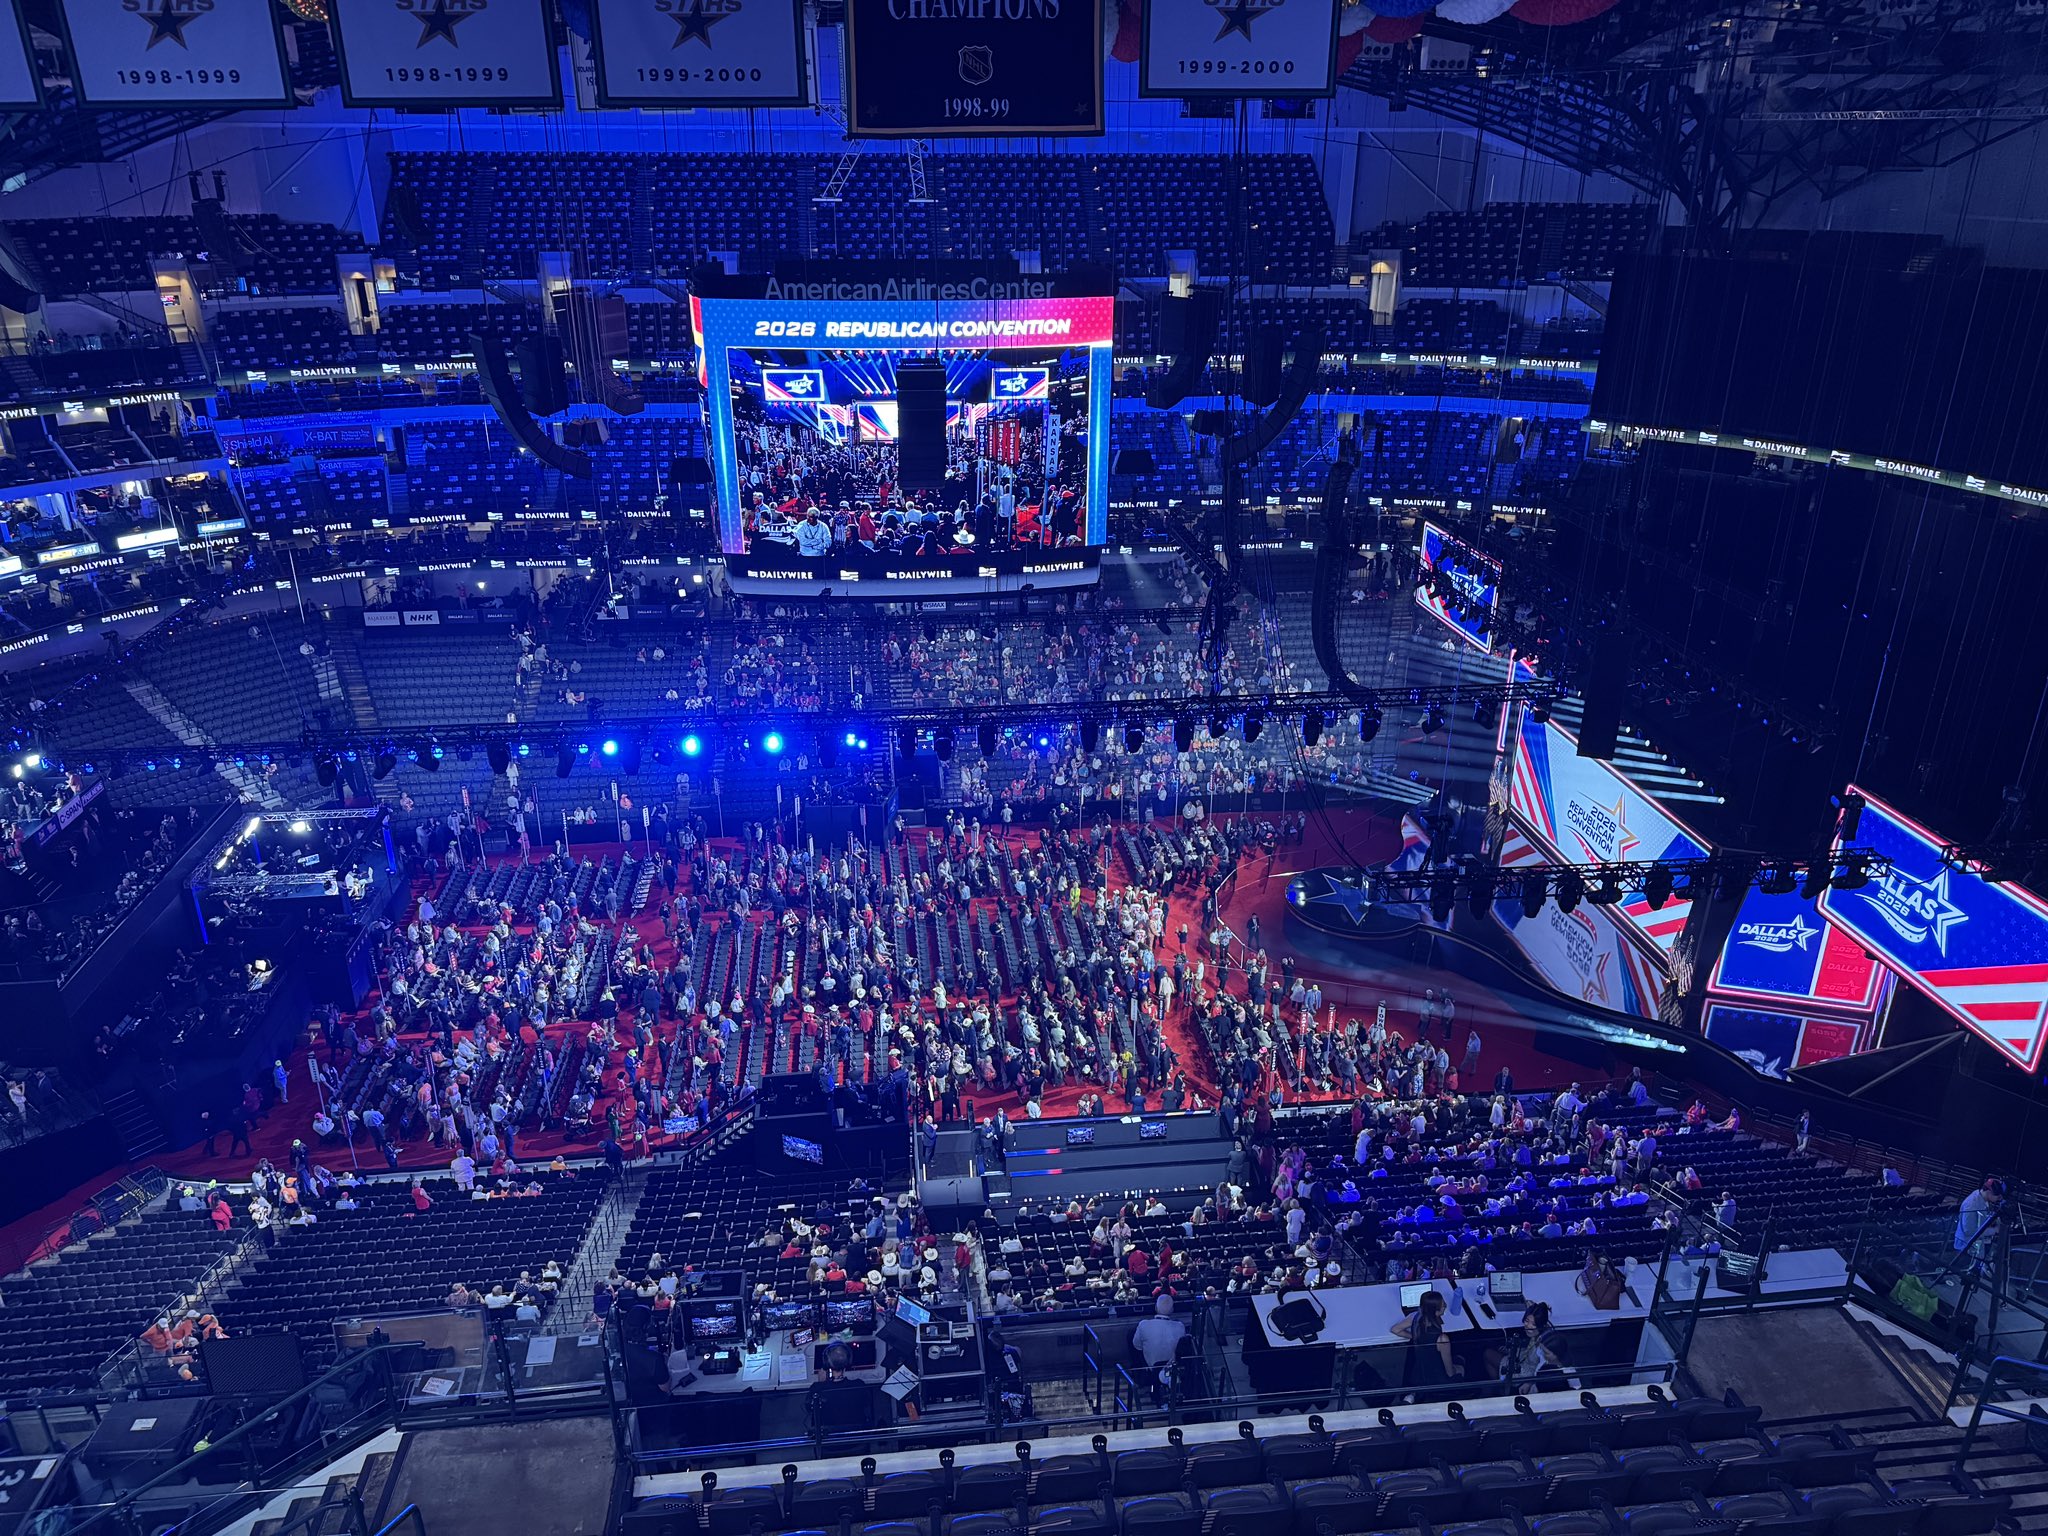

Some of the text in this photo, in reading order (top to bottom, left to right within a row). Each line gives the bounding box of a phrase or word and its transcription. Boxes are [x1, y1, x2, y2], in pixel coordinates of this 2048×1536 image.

[888, 0, 1060, 20] CHAMPIONS
[965, 53, 986, 76] NHL
[1178, 60, 1294, 74] 1999-2000
[117, 70, 240, 84] 1998-1999
[386, 67, 508, 82] 1998-1999
[637, 68, 761, 82] 1999-2000
[943, 97, 1010, 118] 1998-99
[754, 318, 1071, 338] 2026 REPUBLICAN CONVENTION
[1420, 355, 1467, 363] DAILYWIRE
[1531, 359, 1580, 368] DAILYWIRE
[303, 367, 357, 376] DAILYWIRE
[426, 362, 477, 371] DAILYWIRE
[122, 391, 180, 405] DAILYWIRE
[304, 431, 338, 442] X-BAT
[1049, 418, 1058, 474] KANSAS
[1754, 440, 1807, 456] DAILYWIRE
[1887, 461, 1941, 479] DAILYWIRE
[1403, 498, 1446, 507] DAILYWIRE
[420, 513, 466, 524] DAILYWIRE
[525, 511, 570, 520] DAILYWIRE
[759, 525, 791, 533] DALLAS
[190, 536, 239, 550] DAILYWIRE
[71, 556, 124, 573] DAILYWIRE
[428, 562, 471, 571] DAILYWIRE
[526, 559, 566, 567] DAILYWIRE
[1034, 561, 1084, 573] DAILYWIRE
[321, 570, 366, 582] DAILYWIRE
[759, 570, 813, 580] DAILYWIRE
[899, 571, 952, 579] DAILYWIRE
[111, 605, 159, 621] DAILYWIRE
[410, 614, 433, 622] NHK
[2, 633, 49, 653] DAILYWIRE
[60, 799, 82, 823] C-SPAN
[1569, 800, 1615, 845] REPUBLICAN
[1590, 805, 1617, 833] 2026
[1566, 811, 1612, 854] CONVENTION
[1877, 889, 1910, 917] 2026
[1738, 923, 1798, 940] DALLAS
[1831, 945, 1859, 953] 2026
[1827, 962, 1866, 974] DALLAS
